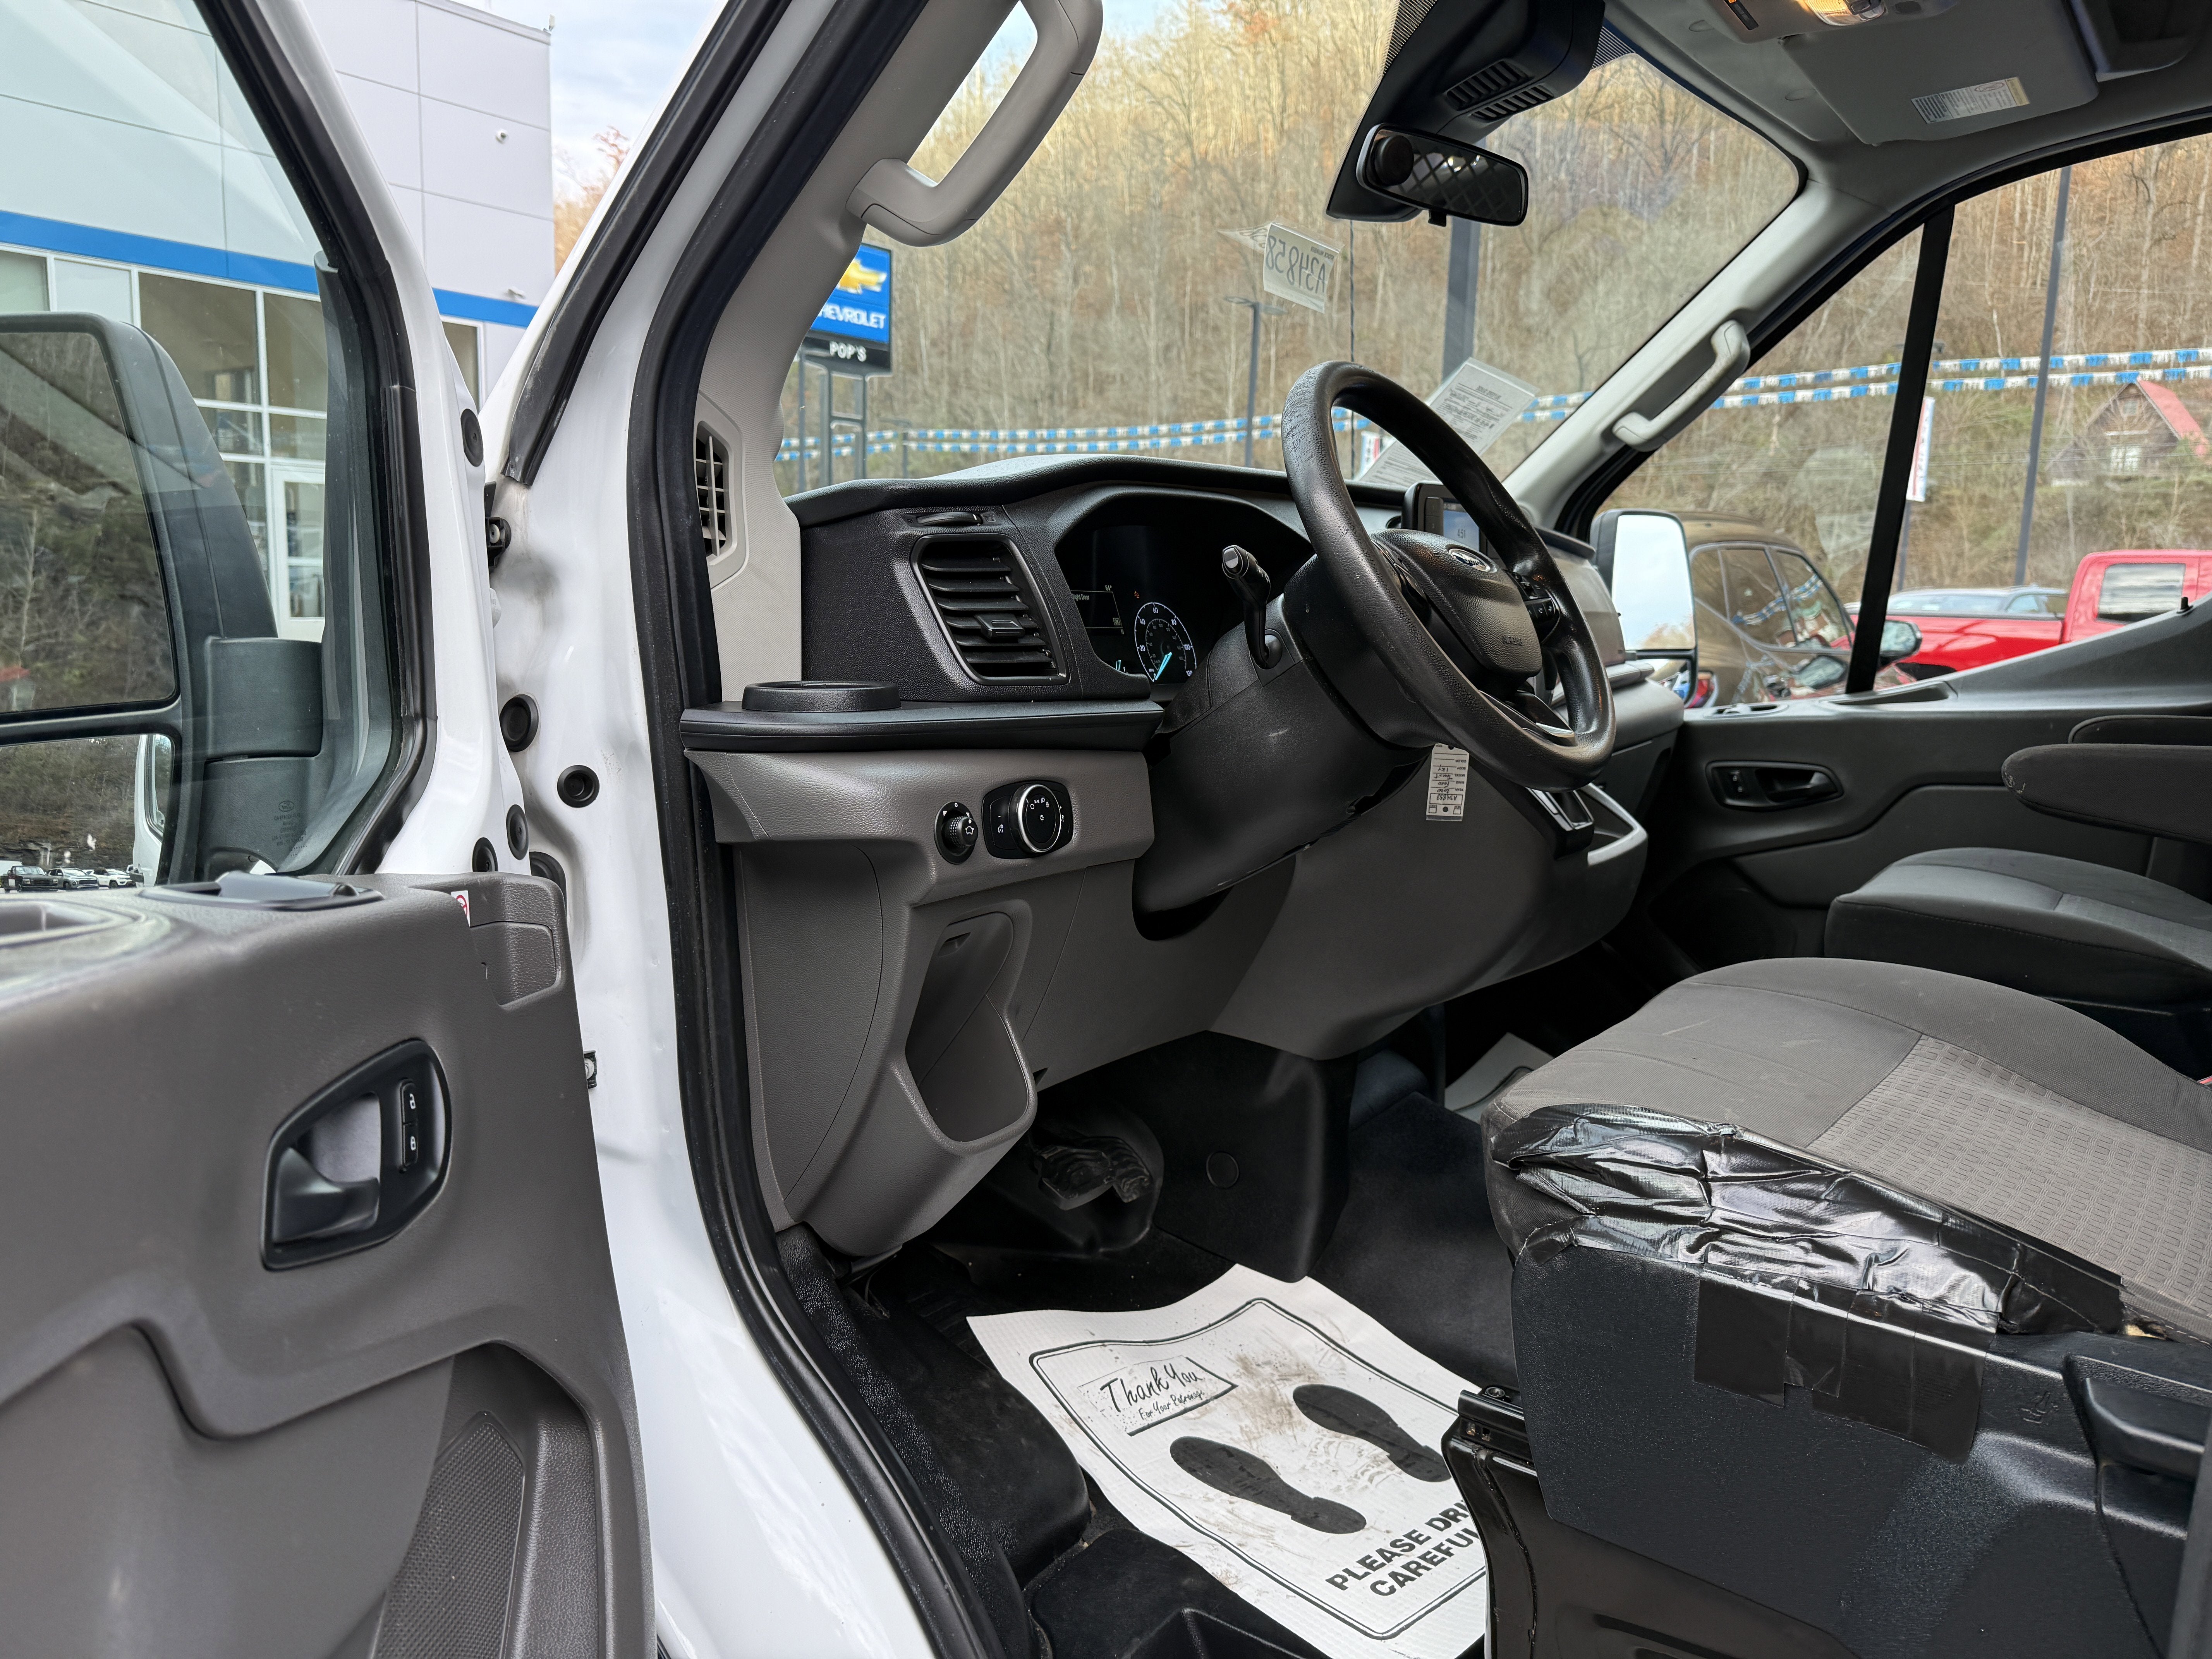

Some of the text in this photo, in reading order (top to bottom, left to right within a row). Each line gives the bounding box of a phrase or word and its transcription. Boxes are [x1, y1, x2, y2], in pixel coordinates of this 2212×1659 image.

[818, 303, 886, 329] HEVROLET
[829, 341, 867, 362] POP'S
[1099, 1362, 1203, 1413] Thank You
[1138, 1389, 1205, 1420] For Your Patronage
[1325, 1500, 1469, 1591] PLEASE DRI
